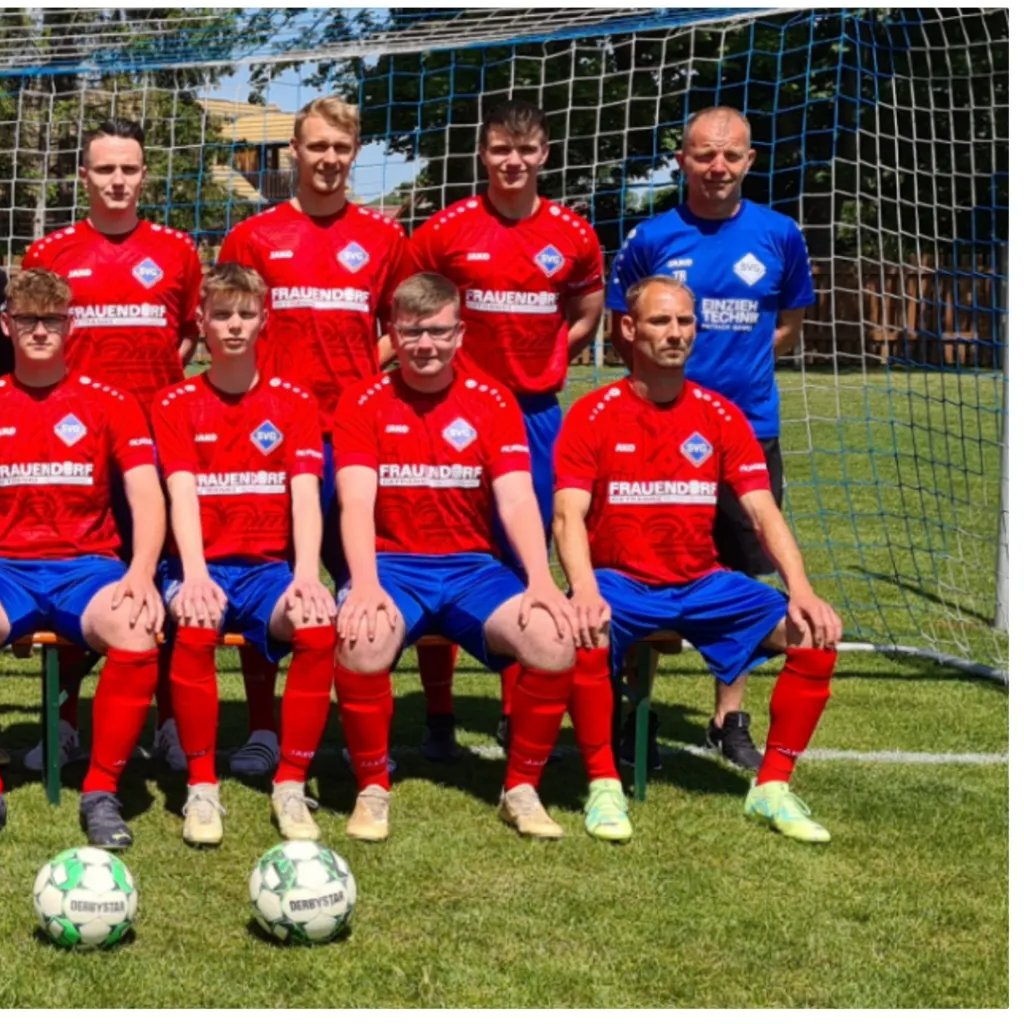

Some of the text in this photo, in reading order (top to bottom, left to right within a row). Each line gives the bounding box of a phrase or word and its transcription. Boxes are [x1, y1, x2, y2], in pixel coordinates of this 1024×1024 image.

[197, 470, 287, 486] RAUENDORF
[70, 899, 126, 914] DERBYSTAR
[289, 890, 344, 913] DERBYSTAR
